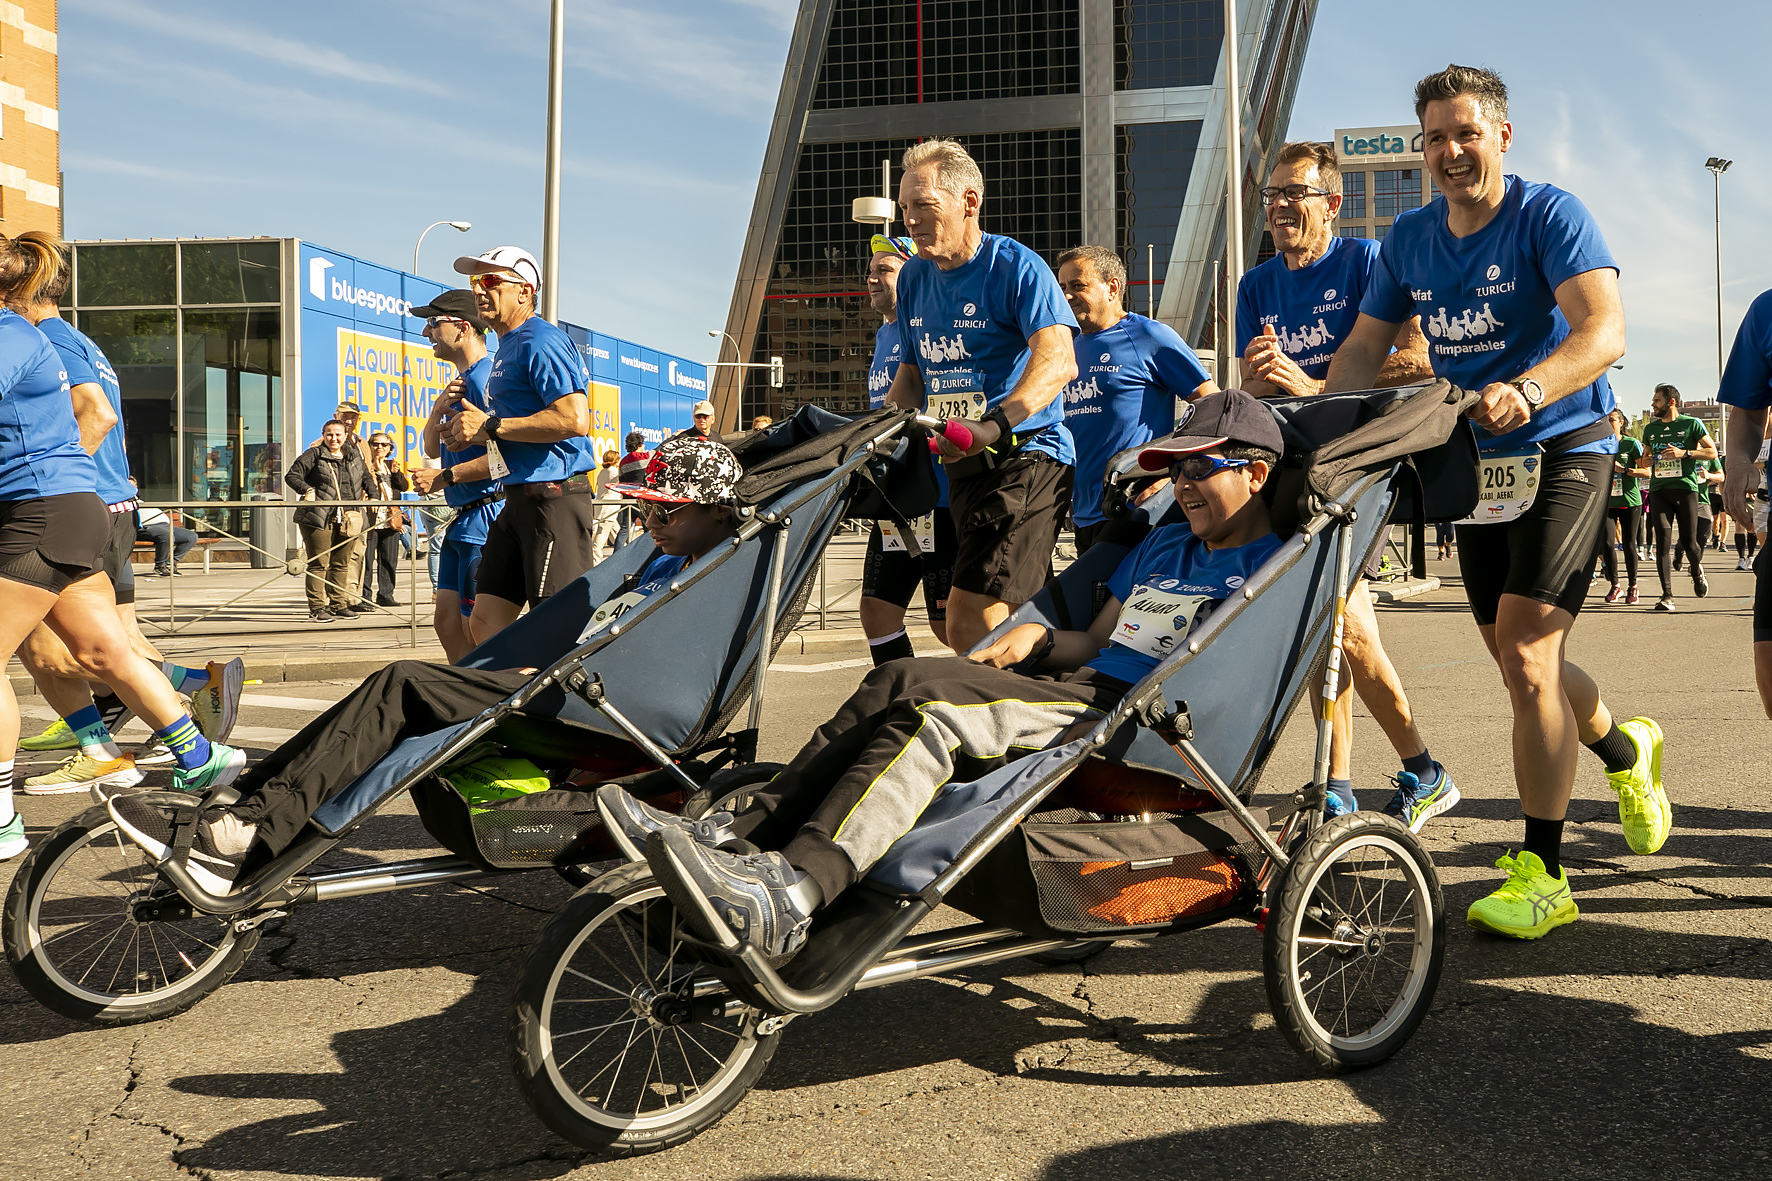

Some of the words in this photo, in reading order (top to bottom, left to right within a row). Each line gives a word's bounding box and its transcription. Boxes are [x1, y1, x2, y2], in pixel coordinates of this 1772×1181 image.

[1343, 133, 1404, 155] testa
[331, 277, 413, 318] bluespace
[1411, 289, 1433, 301] efat
[1476, 281, 1515, 297] ZURICH
[1312, 299, 1347, 315] ZURICH
[953, 319, 986, 329] ZURICH
[1434, 340, 1506, 357] #Imparables
[344, 344, 413, 379] ALQUILA
[416, 357, 433, 382] TU
[1089, 365, 1120, 373] ZURICH
[676, 370, 706, 392] bluespace
[942, 378, 972, 389] ZURICH
[345, 375, 369, 412] EL
[375, 379, 445, 419] PRIME
[938, 400, 969, 419] 6783
[603, 411, 615, 432] AL
[1483, 465, 1516, 489] 205
[1176, 584, 1218, 593] ZURICH
[1129, 597, 1181, 615] ÁLVARO
[211, 686, 221, 713] HOKA
